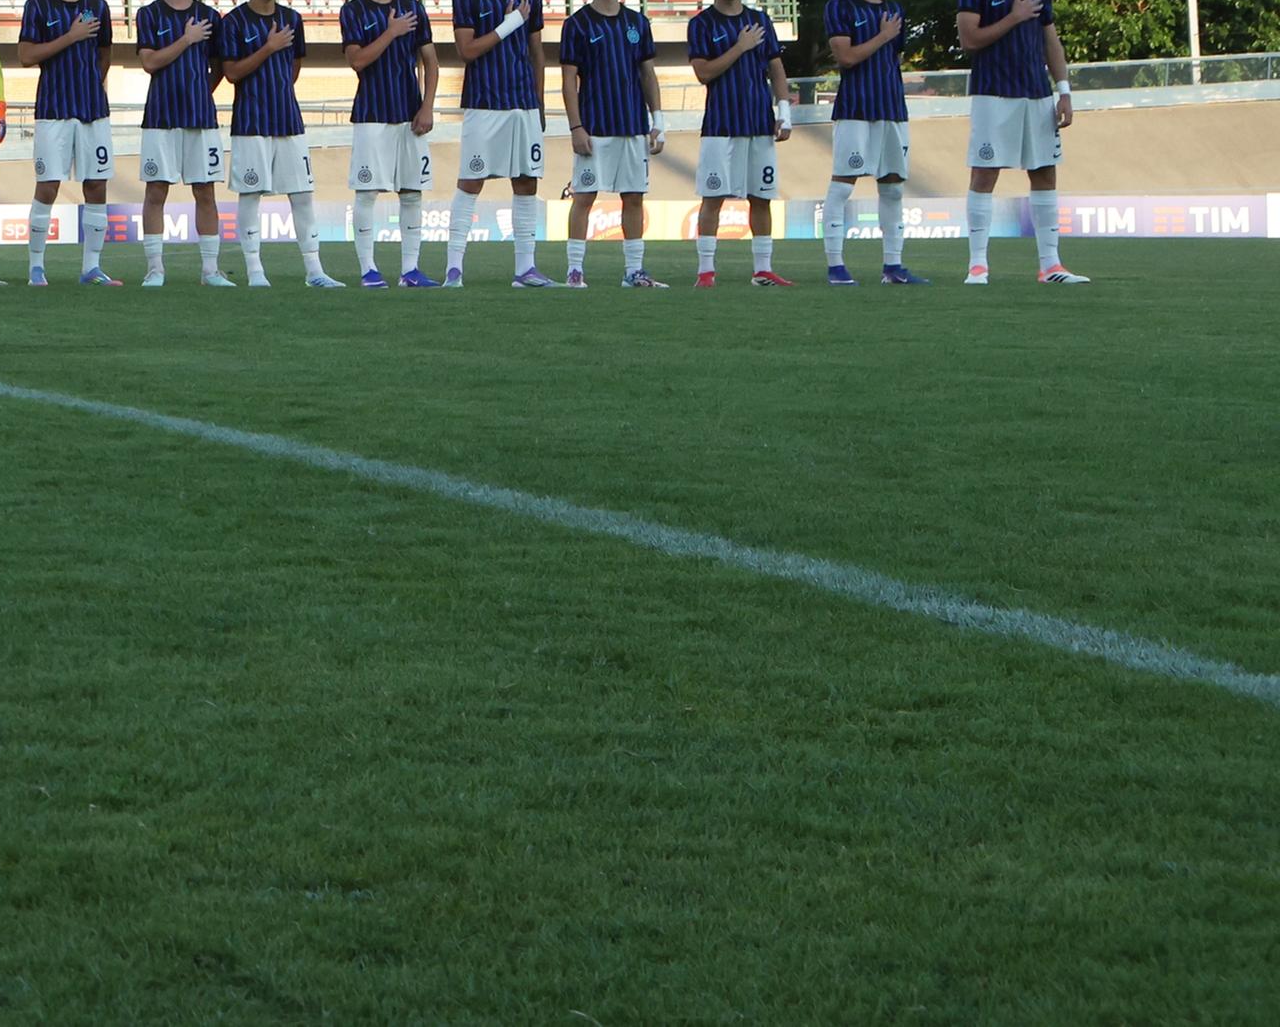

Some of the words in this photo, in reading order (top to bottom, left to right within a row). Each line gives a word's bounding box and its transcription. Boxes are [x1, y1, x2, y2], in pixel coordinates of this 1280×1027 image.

[95, 145, 109, 165] 9
[208, 147, 220, 167] 3
[421, 156, 430, 175] 2
[762, 165, 775, 185] 8
[131, 213, 189, 240] TM
[260, 212, 297, 239] IM
[1075, 206, 1136, 234] TIM
[1189, 206, 1250, 234] TIM
